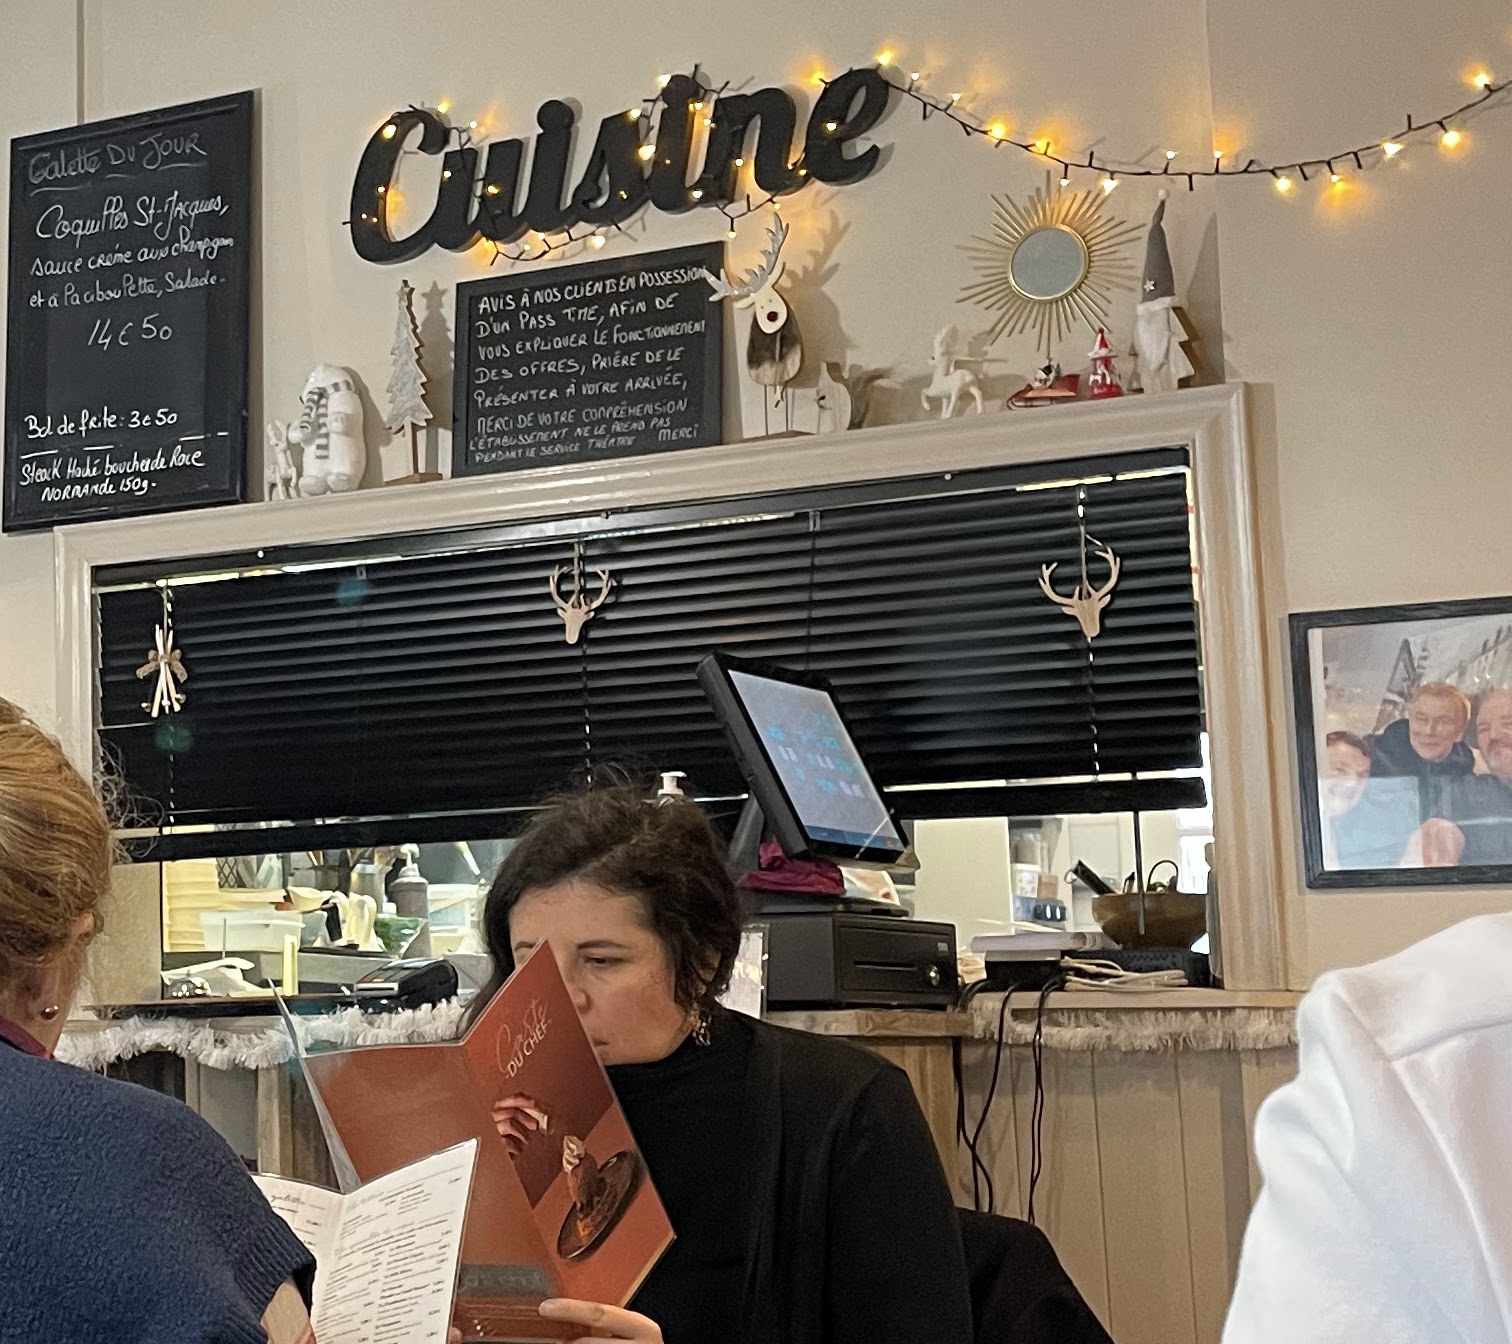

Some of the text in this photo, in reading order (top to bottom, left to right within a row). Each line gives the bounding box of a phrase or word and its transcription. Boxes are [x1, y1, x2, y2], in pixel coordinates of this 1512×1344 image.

[29, 147, 102, 184] Galette
[349, 66, 890, 265] Cuisine
[36, 195, 128, 248] Coquilles
[30, 257, 83, 276] sauce
[138, 247, 169, 262] aux
[29, 289, 46, 308] et
[64, 282, 80, 306] la
[534, 287, 561, 305] NOS
[619, 276, 636, 293] EN
[655, 292, 680, 310] DE
[478, 343, 510, 361] VOUS
[593, 328, 608, 346] LE
[474, 367, 513, 384] DES
[645, 350, 664, 364] DE
[666, 346, 685, 362] LE
[581, 380, 620, 395] VOTRE
[24, 414, 53, 439] Bol
[57, 414, 76, 436] de
[516, 412, 534, 429] DE
[538, 408, 577, 426] VOTRE
[593, 423, 607, 435] LE
[649, 416, 671, 429] PAS
[526, 446, 536, 457] LE
